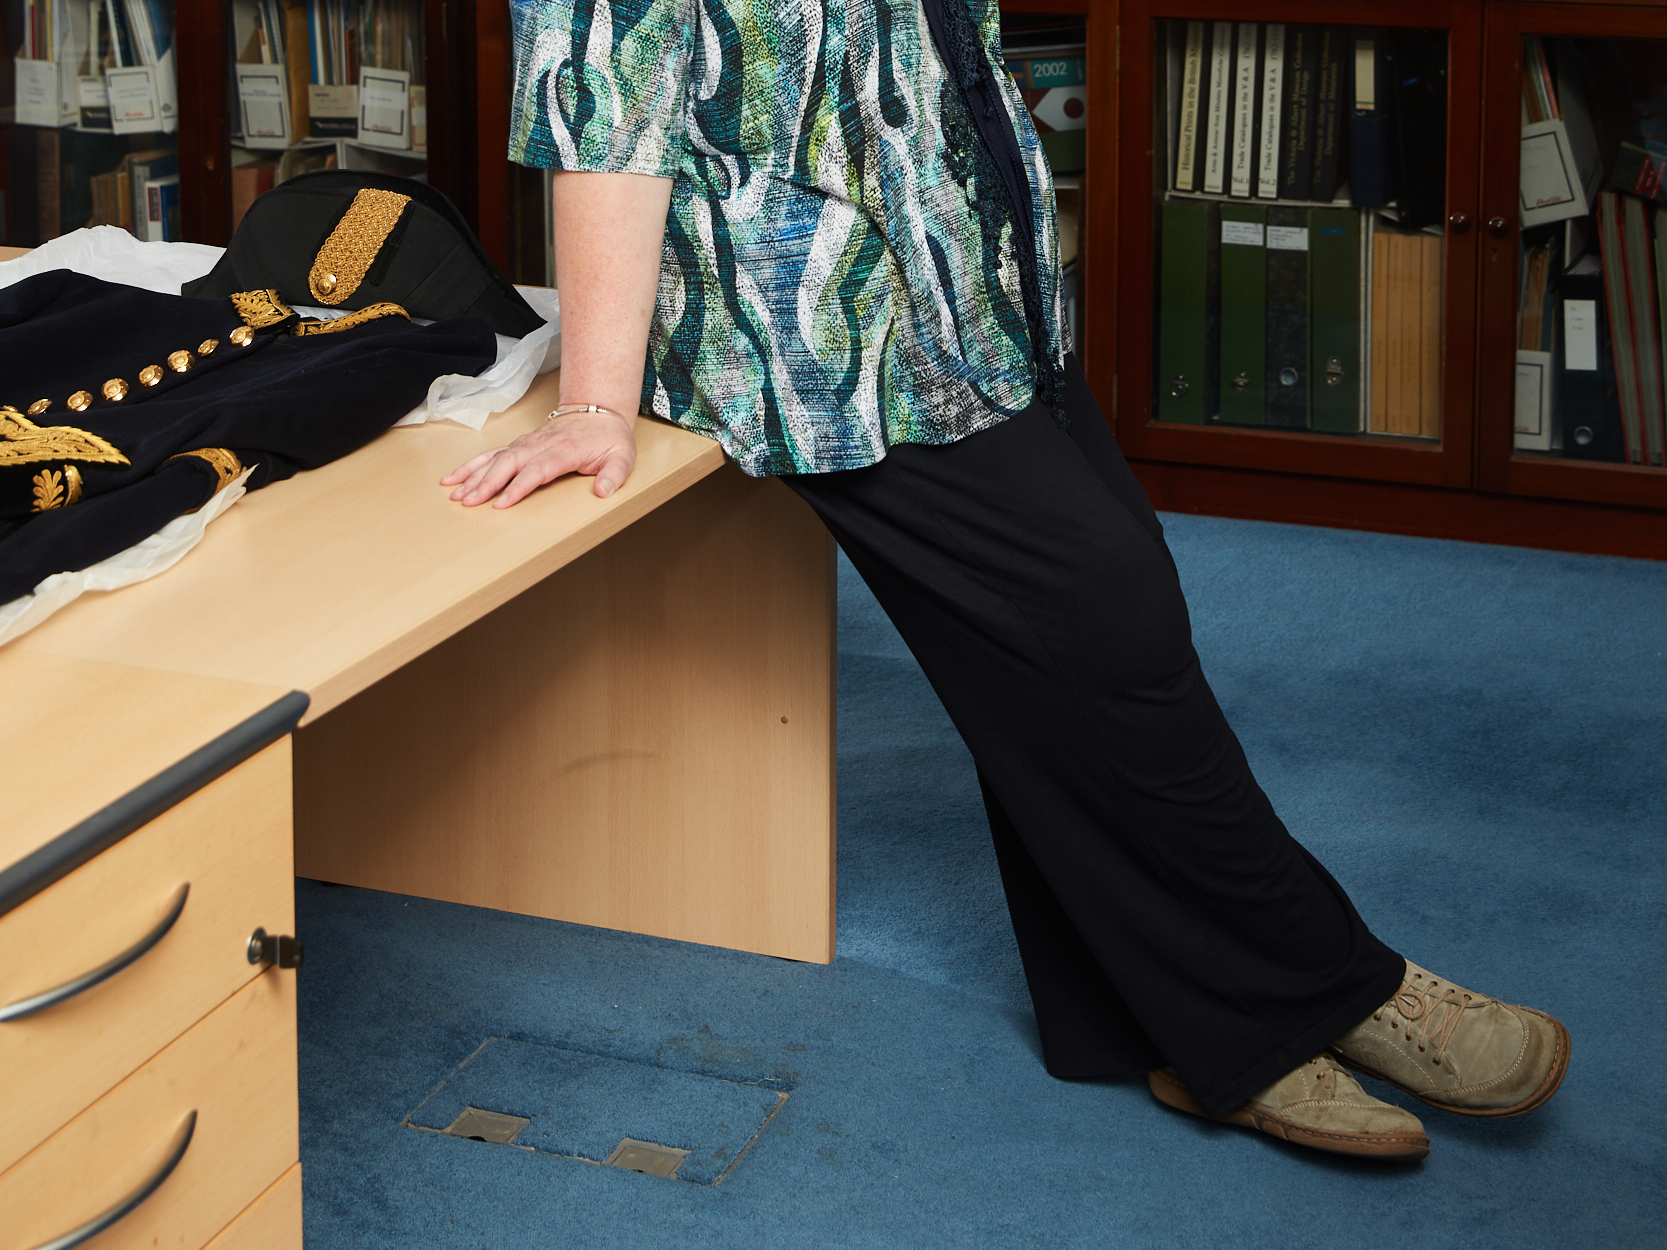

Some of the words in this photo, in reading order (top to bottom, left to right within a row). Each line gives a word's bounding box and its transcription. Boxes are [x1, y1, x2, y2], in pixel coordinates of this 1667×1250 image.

[1321, 32, 1330, 66] Collection
[1034, 62, 1067, 78] 2002
[1188, 60, 1197, 84] British
[1186, 87, 1194, 99] the
[1301, 71, 1310, 94] Design
[1319, 69, 1328, 100] Museum
[1186, 101, 1193, 109] in
[1289, 140, 1297, 167] Victoria
[1294, 33, 1302, 68] Collection
[1300, 97, 1307, 105] of
[1327, 103, 1334, 111] of
[1184, 111, 1193, 132] Prints
[1238, 113, 1248, 148] Catalogues
[1266, 114, 1275, 150] Catalogues
[1298, 108, 1306, 150] Department
[1325, 114, 1333, 155] Department
[1182, 134, 1192, 170] Historical
[1237, 151, 1245, 170] Trade
[1264, 153, 1272, 171] Trade
[1315, 138, 1324, 165] Victoria
